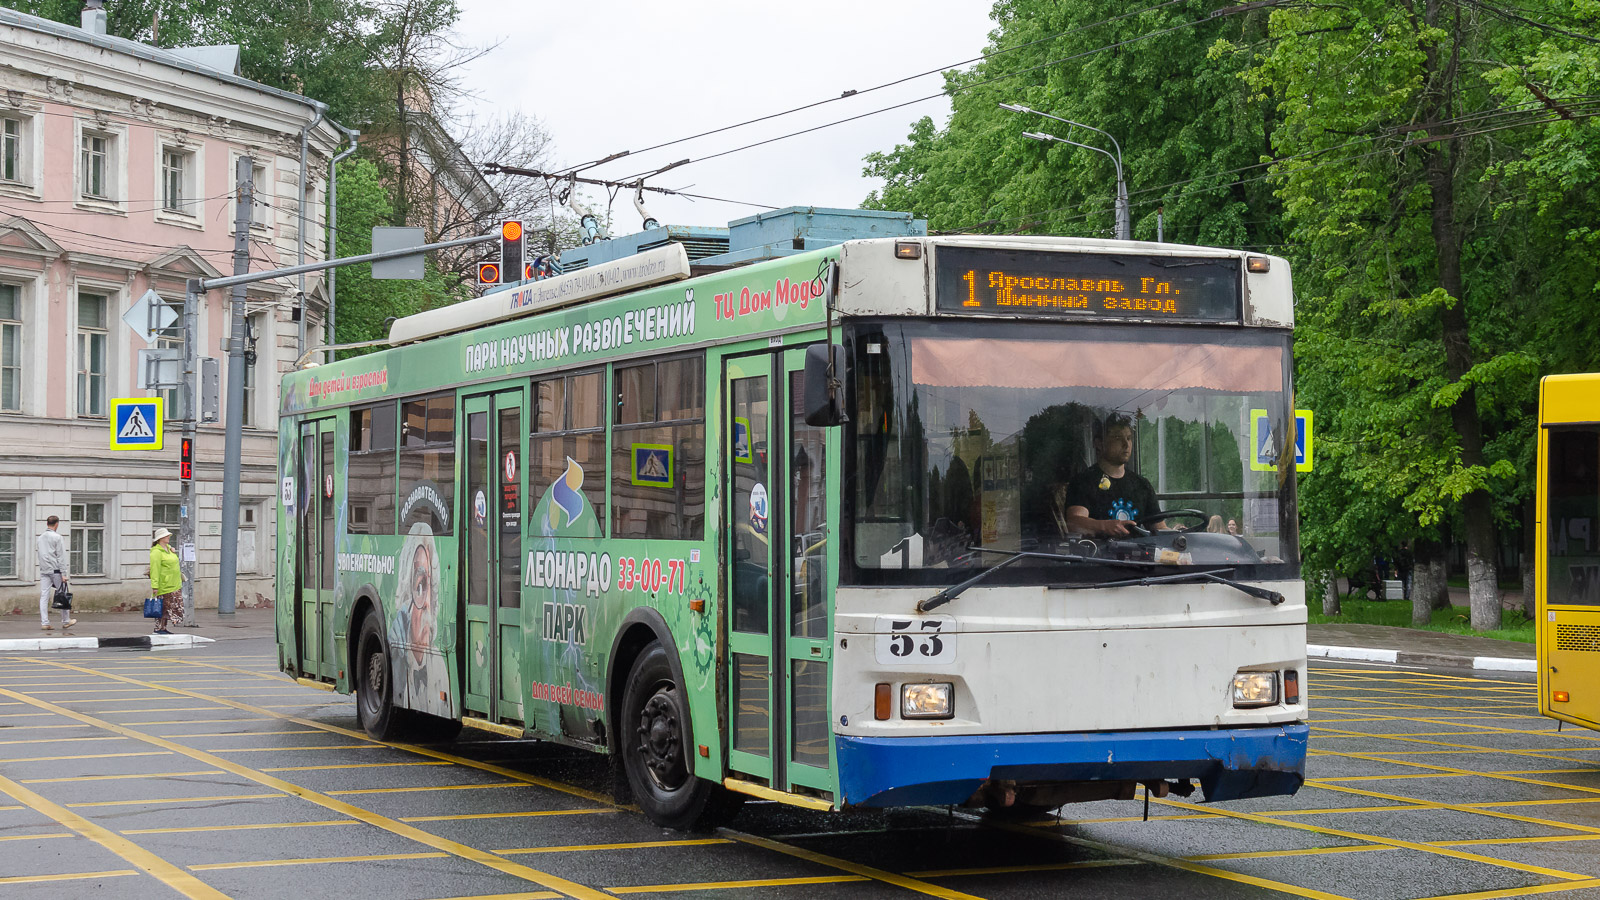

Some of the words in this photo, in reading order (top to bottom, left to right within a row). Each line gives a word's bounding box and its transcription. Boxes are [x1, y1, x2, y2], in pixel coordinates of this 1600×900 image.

[510, 287, 533, 309] TROLZA
[714, 291, 735, 321] ТЦ
[738, 286, 772, 316] Дом
[775, 278, 823, 310] Моды
[962, 270, 981, 307] 1
[988, 271, 1125, 293] Ярославль
[1140, 277, 1182, 295] Гл.
[996, 288, 1089, 309] Шинный
[1103, 296, 1177, 314] завод
[465, 343, 499, 374] ПАРК
[500, 326, 570, 368] НАУЧНЫХ
[573, 288, 697, 357] РАЗВЛЕЧЕНИЙ
[308, 377, 321, 396] Для
[322, 370, 344, 399] детей
[345, 375, 350, 390] и
[351, 369, 387, 394] взрослых
[284, 482, 291, 500] 53
[401, 484, 448, 526] ПОЗНАВАТЕЛЬНО!
[337, 552, 394, 574] УВЛЕКАТЕЛЬНО!
[524, 549, 612, 598] ЛЕОНАРДО
[617, 557, 685, 595] 33-00-71
[542, 601, 586, 646] ПАРК
[889, 621, 943, 657] 53
[532, 680, 549, 701] ДЛЯ
[550, 682, 572, 706] ВСЕЙ
[573, 687, 604, 712] СЕМЬИ
